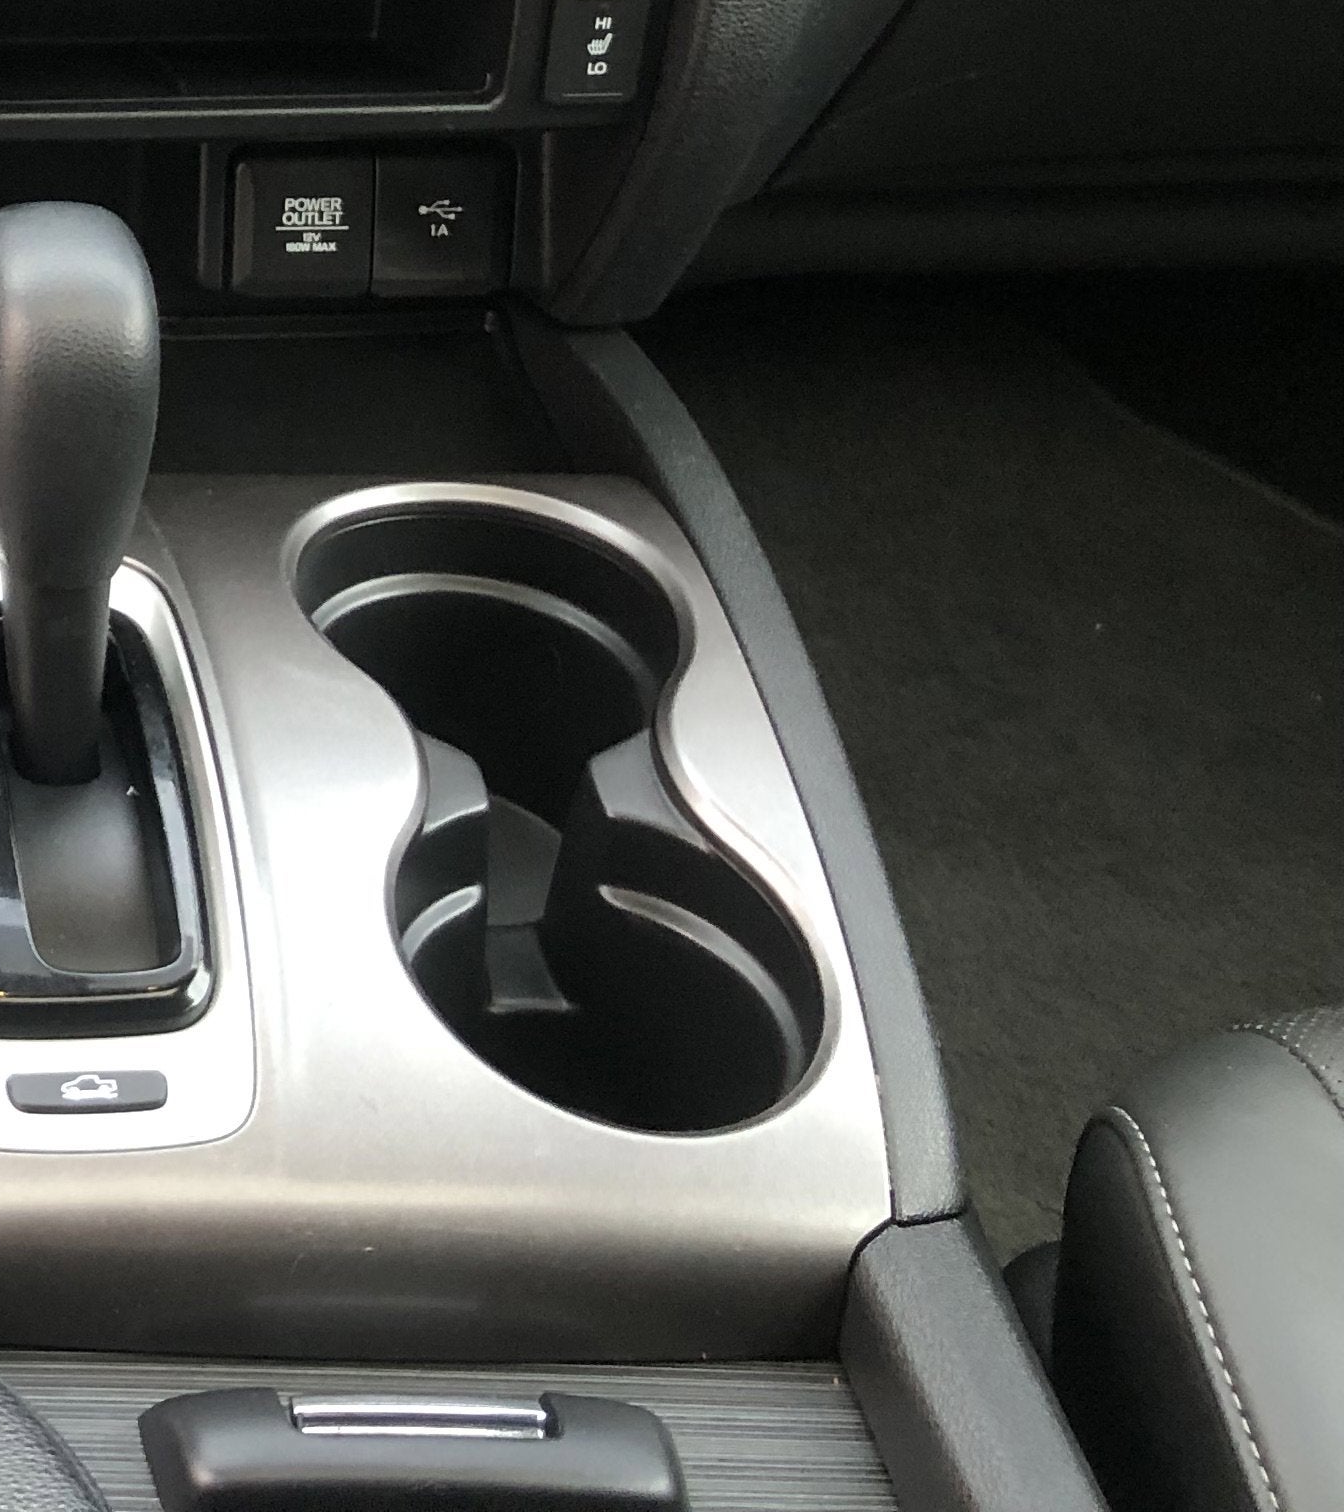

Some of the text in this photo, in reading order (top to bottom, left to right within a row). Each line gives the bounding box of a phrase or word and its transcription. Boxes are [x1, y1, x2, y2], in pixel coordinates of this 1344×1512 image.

[595, 17, 612, 30] HI
[587, 61, 608, 75] LO
[284, 197, 342, 213] POWER
[282, 211, 342, 226] OUTLET
[312, 241, 337, 252] MAX
